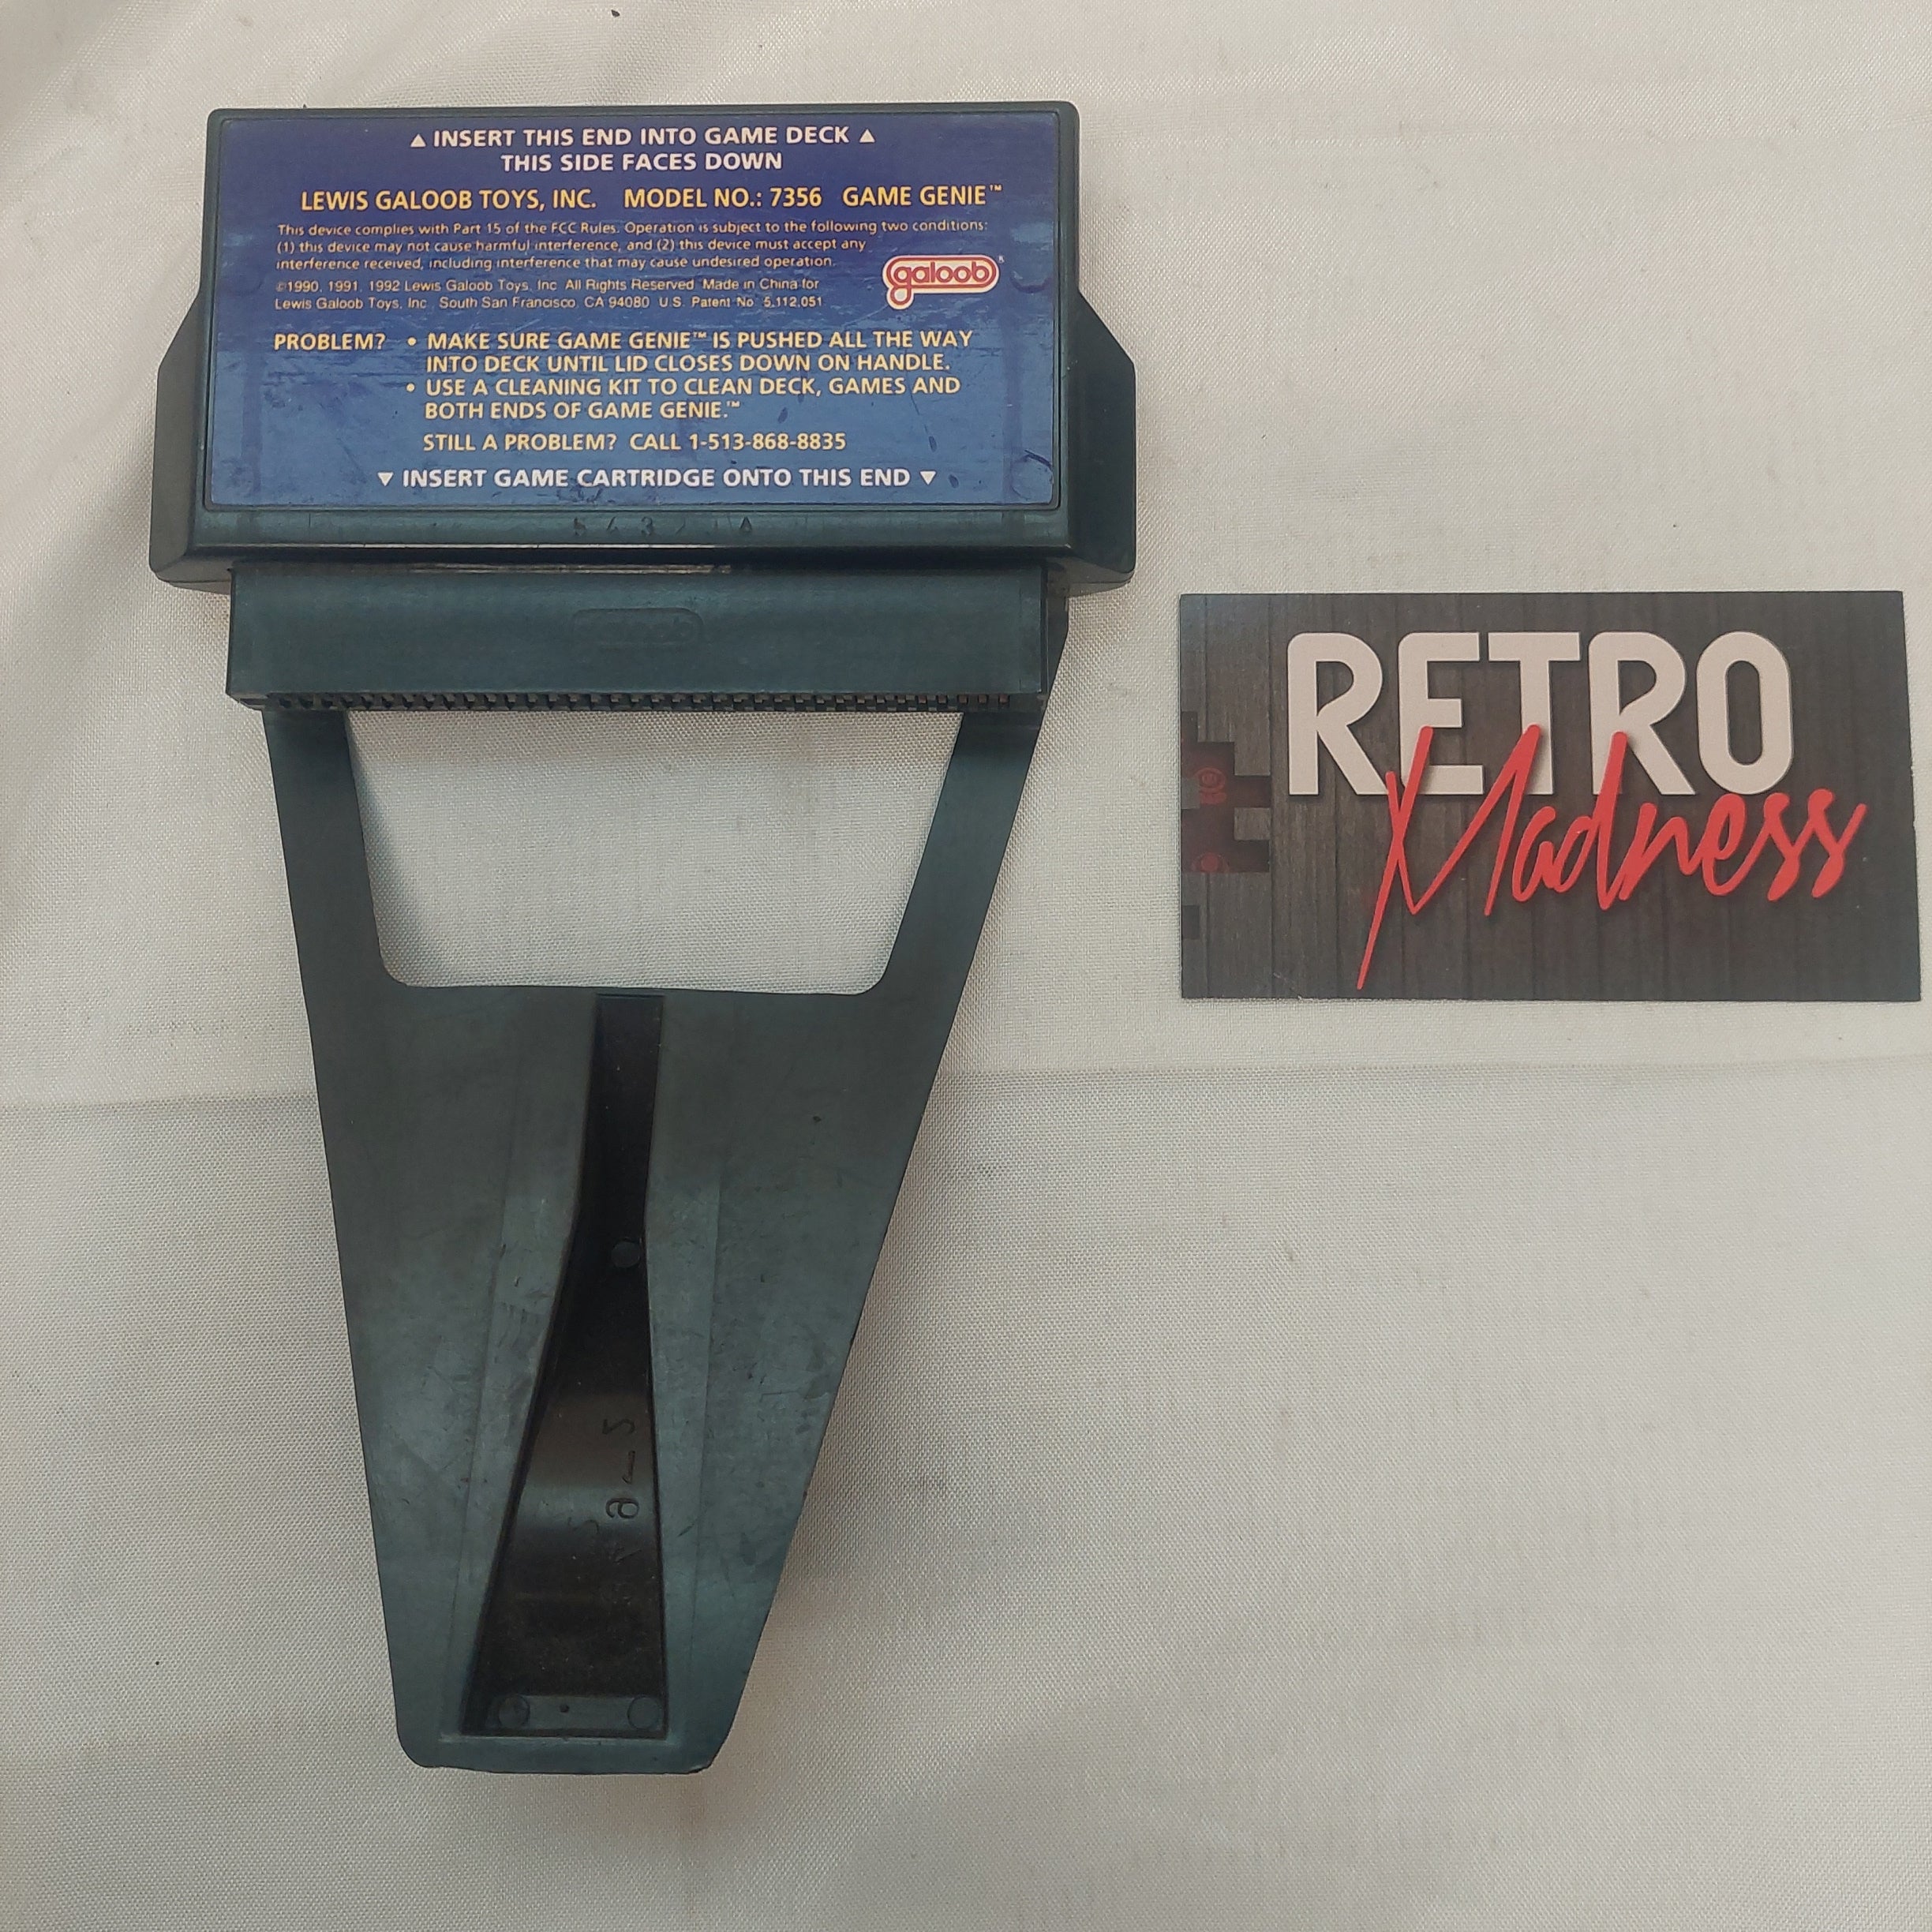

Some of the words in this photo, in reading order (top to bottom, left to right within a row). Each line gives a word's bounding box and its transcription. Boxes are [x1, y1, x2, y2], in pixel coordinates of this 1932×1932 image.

[433, 129, 516, 148] INSERT
[522, 128, 574, 146] THIS
[582, 128, 631, 146] END
[641, 127, 696, 145] INTO
[704, 126, 777, 144] GAME
[786, 125, 849, 144] DECK
[500, 154, 552, 172] THIS
[560, 154, 614, 171] SIDE
[622, 152, 697, 171] FACES
[705, 152, 782, 170] DOWN
[301, 190, 369, 211] LEWIS
[375, 189, 472, 211] GALOOB
[478, 189, 545, 212] TOYS,
[553, 189, 597, 208] INC.
[624, 188, 708, 208] MODEL
[714, 187, 762, 208] NO.:
[769, 187, 822, 207] 7356
[842, 186, 912, 207] GAME
[277, 224, 305, 236] This
[308, 223, 352, 236] device
[355, 223, 414, 238] complies
[418, 223, 449, 235] with
[453, 223, 481, 234] Part
[487, 223, 501, 234] 15
[505, 221, 520, 234] of
[524, 222, 547, 234] the
[551, 222, 576, 234] FCC
[580, 222, 620, 234] Rules.
[624, 221, 695, 235] Operation
[698, 223, 709, 233] is
[712, 221, 761, 236] subject
[765, 222, 780, 233] to
[784, 220, 807, 233] the
[811, 219, 877, 235] following
[881, 221, 908, 232] two
[912, 219, 988, 232] conditions:
[277, 241, 295, 254] (1)
[298, 240, 324, 253] this
[328, 241, 370, 253] device
[374, 242, 402, 255] may
[407, 242, 430, 252] not
[434, 242, 472, 253] cause
[476, 239, 530, 252] harmful
[534, 238, 621, 253] interference,
[627, 239, 653, 251] and
[657, 238, 675, 253] (2)
[679, 238, 704, 250] this
[707, 238, 751, 250] device
[755, 239, 788, 250] must
[792, 238, 837, 252] accept
[841, 240, 867, 253] any
[276, 256, 360, 271] interference
[429, 256, 492, 272] including
[496, 256, 581, 268] interference
[584, 256, 613, 268] that
[617, 258, 646, 271] may
[650, 257, 688, 268] cause
[692, 255, 760, 268] undesired
[369, 279, 400, 292] 1992
[404, 280, 441, 292] Lewis
[445, 279, 493, 292] Galoob
[565, 279, 582, 290] All
[586, 279, 627, 294] Rights
[702, 278, 739, 290] Made
[743, 280, 755, 290] in
[759, 278, 798, 290] China
[802, 278, 820, 290] for
[887, 260, 991, 306] galoob
[275, 298, 313, 310] Lewis
[316, 297, 364, 309] Galoob
[439, 296, 478, 309] South
[481, 296, 508, 309] San
[584, 296, 605, 308] CA
[608, 295, 650, 309] 94080
[691, 295, 731, 308] Patent
[274, 332, 386, 350] PROBLEM?
[428, 332, 490, 350] MAKE
[497, 331, 551, 350] SURE
[557, 331, 622, 350] GAME
[713, 331, 731, 349] IS
[737, 331, 822, 349] PUSHED
[829, 331, 867, 348] ALL
[872, 330, 913, 348] THE
[919, 330, 973, 347] WAY
[426, 355, 477, 373] INTO
[485, 355, 540, 373] DECK
[548, 355, 608, 373] UNTIL
[615, 355, 648, 373] LID
[654, 354, 733, 373] CLOSES
[739, 354, 811, 372] DOWN
[818, 354, 850, 372] ON
[857, 353, 950, 371] HANDLE.
[426, 379, 466, 396] USE
[472, 379, 489, 396] A
[495, 378, 601, 396] CLEANING
[608, 378, 642, 395] KIT
[647, 378, 677, 395] TO
[683, 378, 752, 395] CLEAN
[759, 377, 822, 397] DECK,
[829, 377, 906, 395] GAMES
[912, 376, 960, 394] AND
[425, 402, 484, 419] BOTH
[490, 402, 546, 419] ENDS
[553, 402, 582, 419] OF
[588, 401, 653, 419] GAME
[423, 433, 476, 451] STILL
[481, 433, 498, 451] A
[504, 433, 617, 451] PROBLEM?
[630, 433, 681, 451] CALL
[689, 432, 846, 451] 1-513-868-8835
[402, 469, 488, 488] INSERT
[494, 469, 569, 487] GAME
[577, 469, 715, 487] CARTRIDGE
[723, 468, 792, 487] ONTO
[799, 468, 852, 486] THIS
[860, 468, 911, 486] END
[1287, 631, 1795, 796] RETRO
[1357, 724, 1867, 990] Madness
